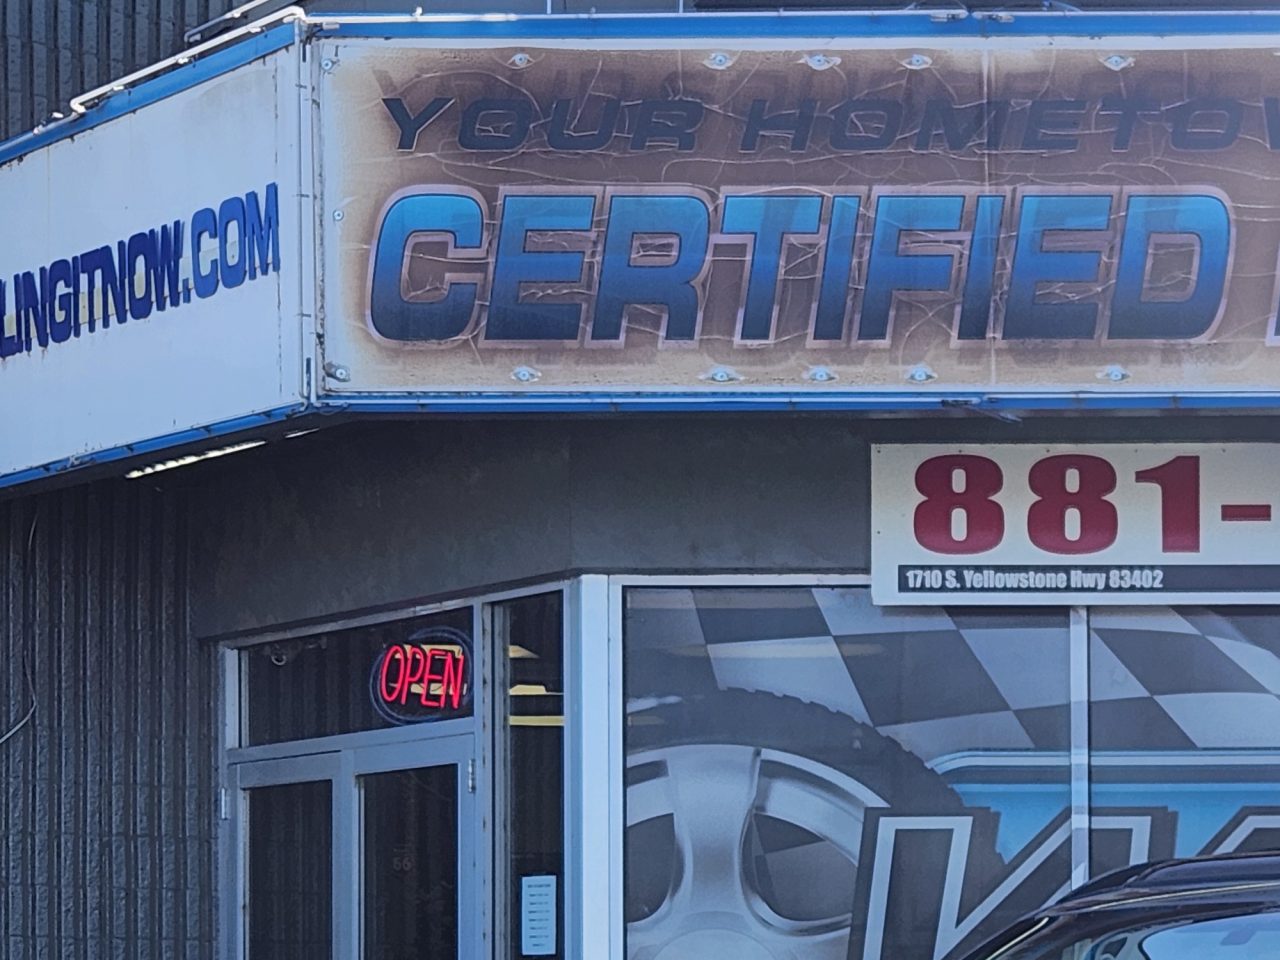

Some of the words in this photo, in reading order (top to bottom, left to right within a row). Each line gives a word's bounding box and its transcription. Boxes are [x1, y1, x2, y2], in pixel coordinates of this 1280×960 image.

[382, 97, 713, 152] YOUR
[368, 186, 1236, 348] CERTIFIED
[905, 569, 942, 590] 1710
[944, 569, 962, 590] S.
[963, 569, 1068, 590] Yellowstone
[1070, 569, 1107, 591] Hwy
[1108, 568, 1164, 590] 83402
[381, 644, 465, 710] OPEN
